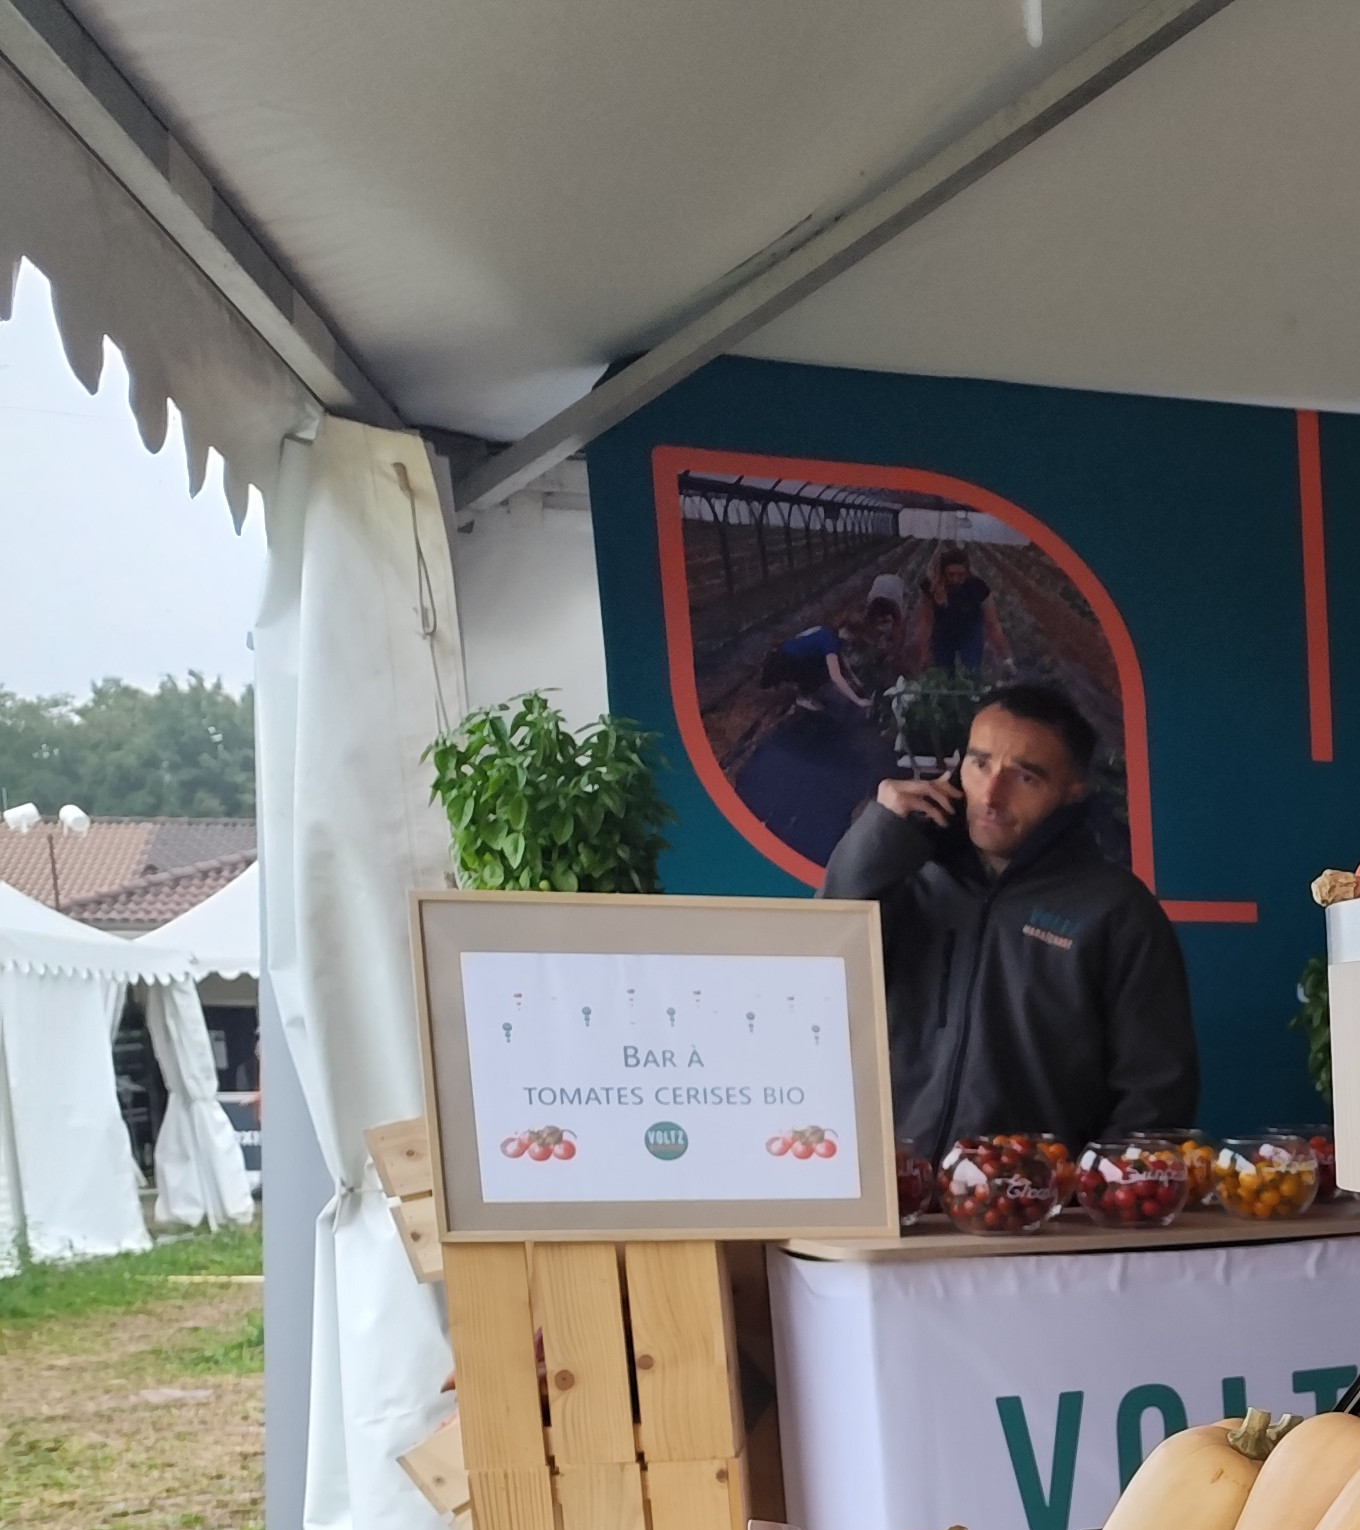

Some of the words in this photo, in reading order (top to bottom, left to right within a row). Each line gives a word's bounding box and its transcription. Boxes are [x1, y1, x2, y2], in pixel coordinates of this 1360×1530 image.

[687, 1043, 705, 1068] À
[523, 1086, 644, 1106] TOMATES
[654, 1086, 752, 1106] CERISES
[763, 1086, 806, 1106] BIO
[647, 1129, 685, 1145] VOLTZ
